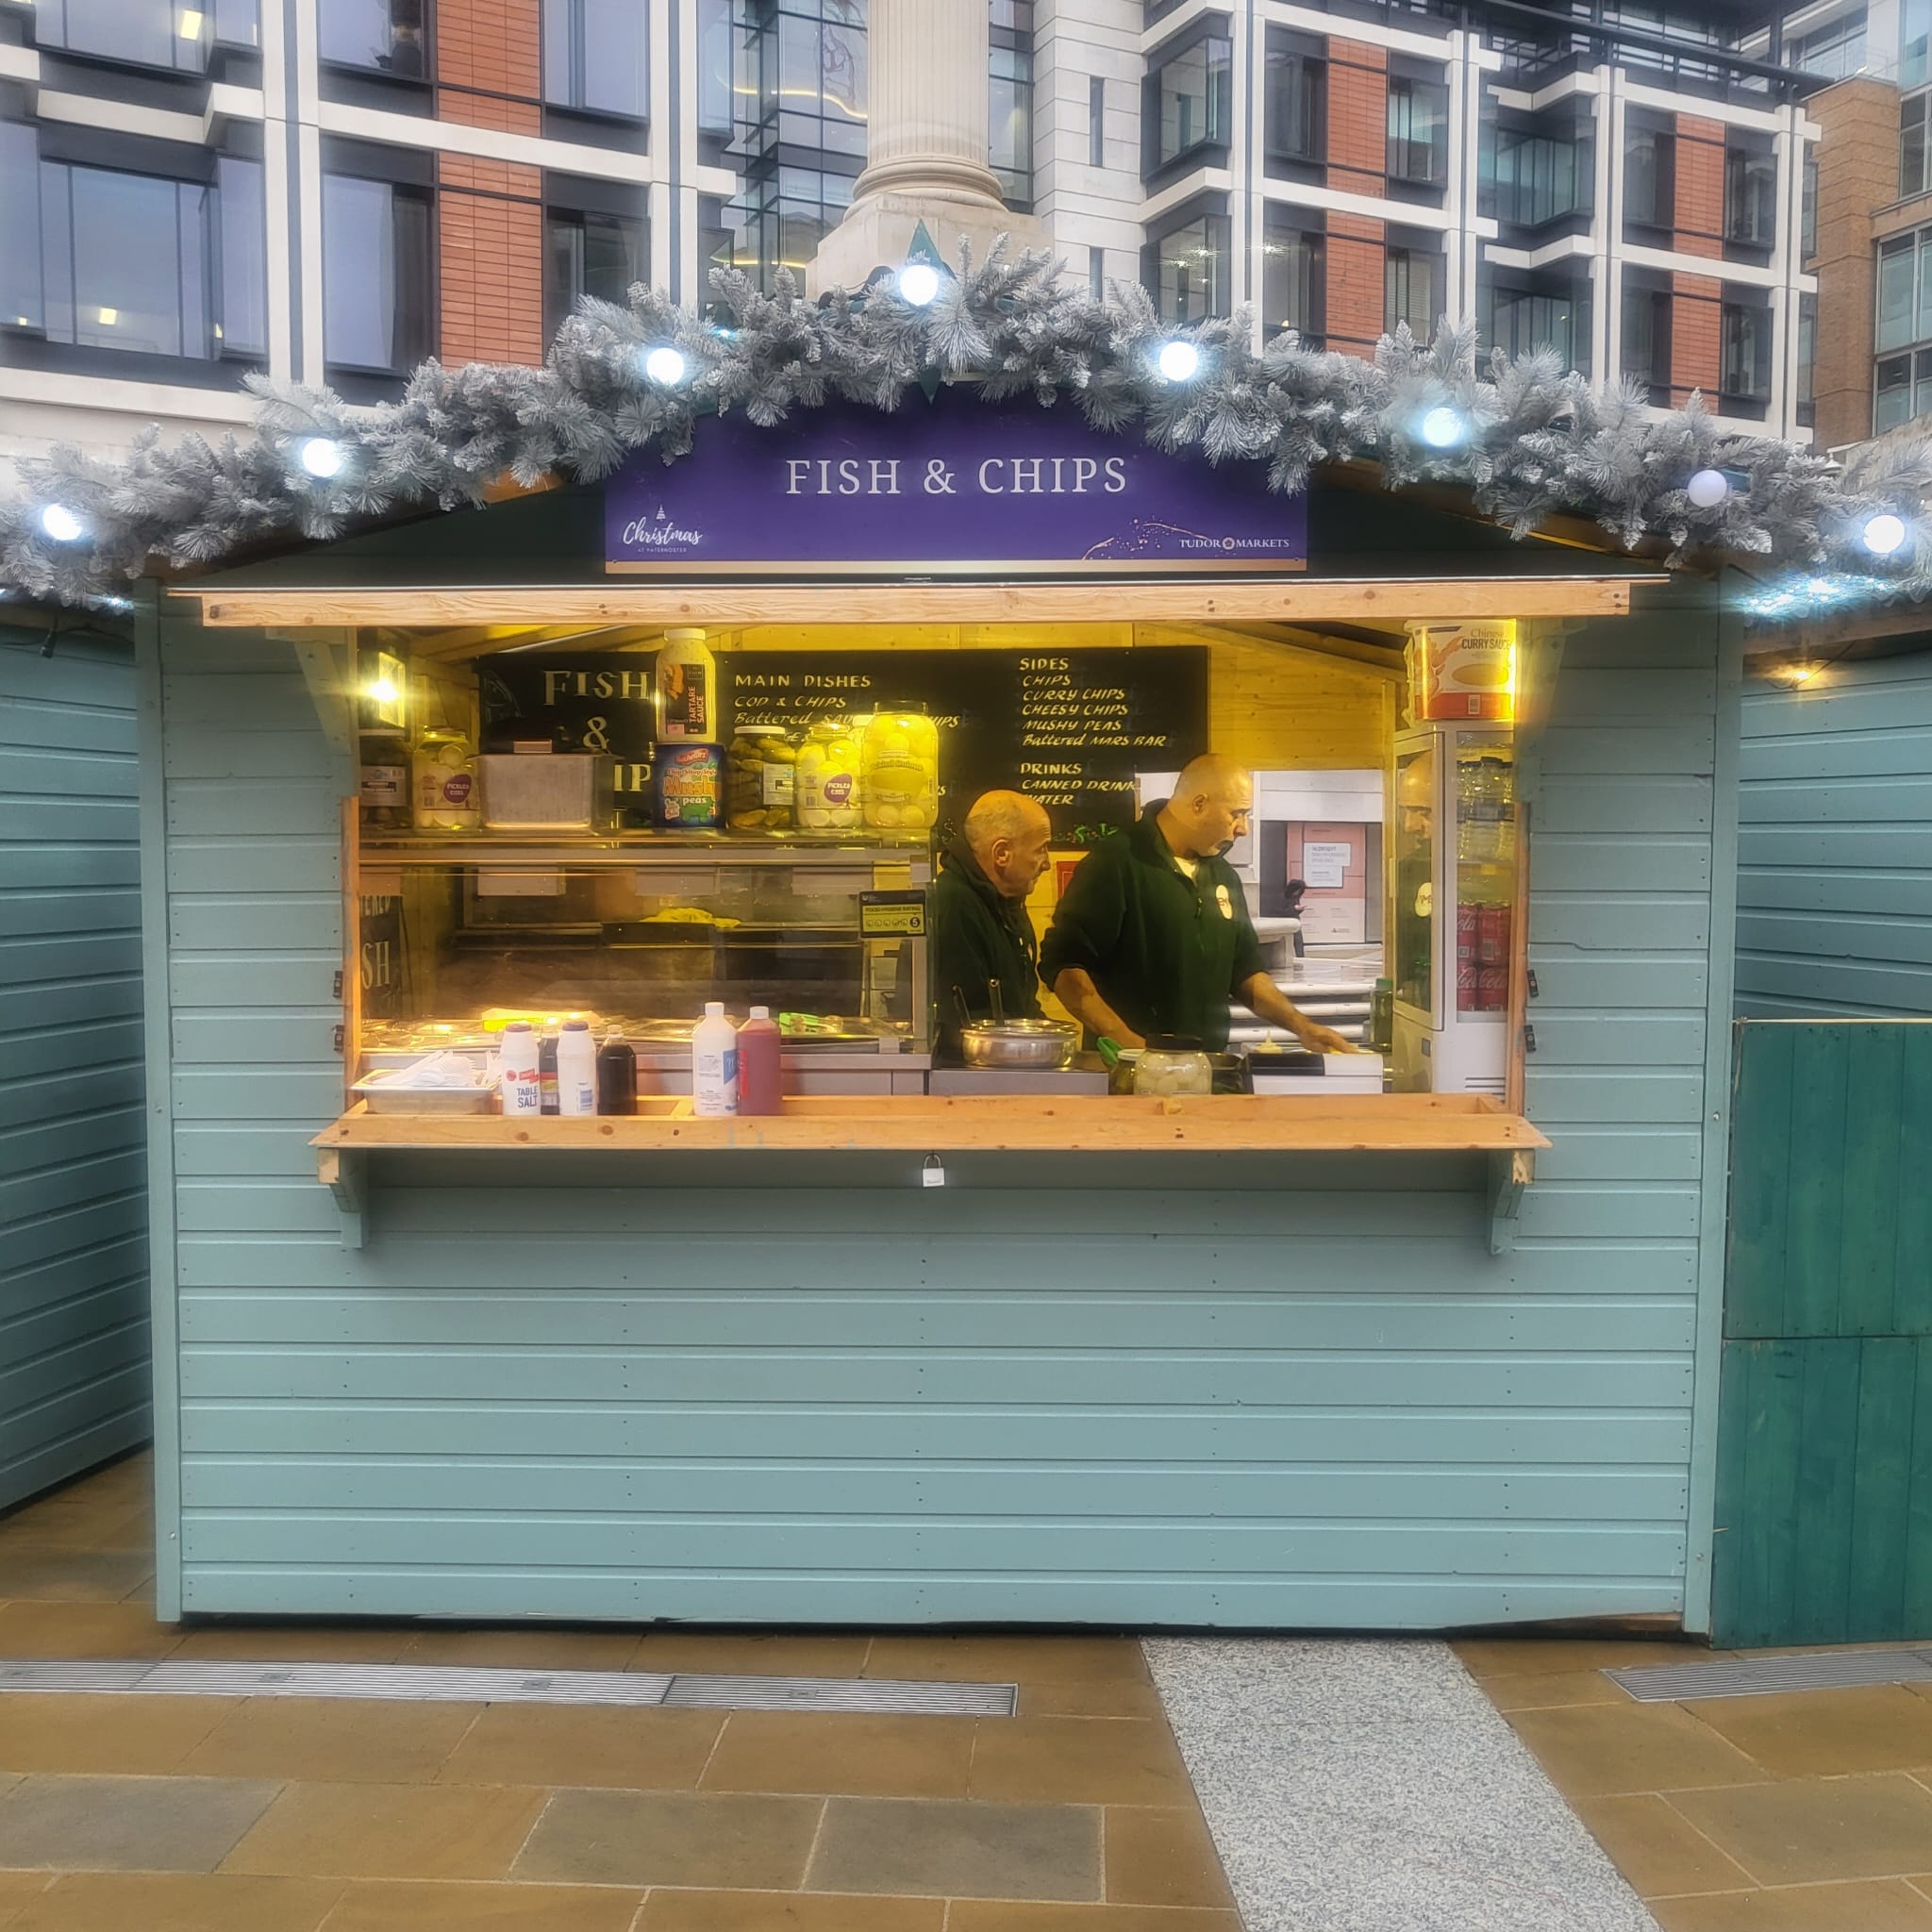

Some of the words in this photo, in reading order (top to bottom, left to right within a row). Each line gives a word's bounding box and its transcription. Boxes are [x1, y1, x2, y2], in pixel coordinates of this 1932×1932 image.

[785, 459, 902, 494] FISH
[923, 458, 957, 494] &
[978, 457, 1126, 493] CHIPS
[623, 516, 703, 545] Christmas
[1178, 539, 1222, 548] TUDOR
[1236, 539, 1291, 548] MARKETS
[1461, 638, 1488, 650] CURRY
[1490, 637, 1511, 650] SAUCE
[1019, 658, 1070, 671] SIDES
[735, 674, 791, 687] MAIN
[804, 674, 872, 688] DISHES
[1022, 674, 1072, 687] CHIPS
[542, 670, 651, 706] FISH
[1023, 689, 1079, 701] CURRY
[1082, 688, 1126, 700] CHIPS
[688, 686, 696, 724] TARTARE
[776, 697, 787, 707] &
[794, 695, 847, 708] CHIPS
[696, 695, 705, 724] SAUCE
[1022, 704, 1080, 716] CHEESY
[1083, 704, 1128, 716] CHIPS
[734, 711, 813, 724] Battered
[1023, 720, 1079, 731] MUSHY
[1085, 720, 1123, 731] PEAS
[582, 716, 614, 755] &
[1022, 733, 1087, 746] Battered
[1090, 736, 1130, 746] MARS
[1133, 735, 1167, 746] BAR
[1020, 762, 1083, 774] DRINKS
[1022, 779, 1083, 791] CANNED
[682, 797, 707, 806] peas
[517, 1086, 539, 1096] TABLE
[517, 1095, 538, 1108] SALT
